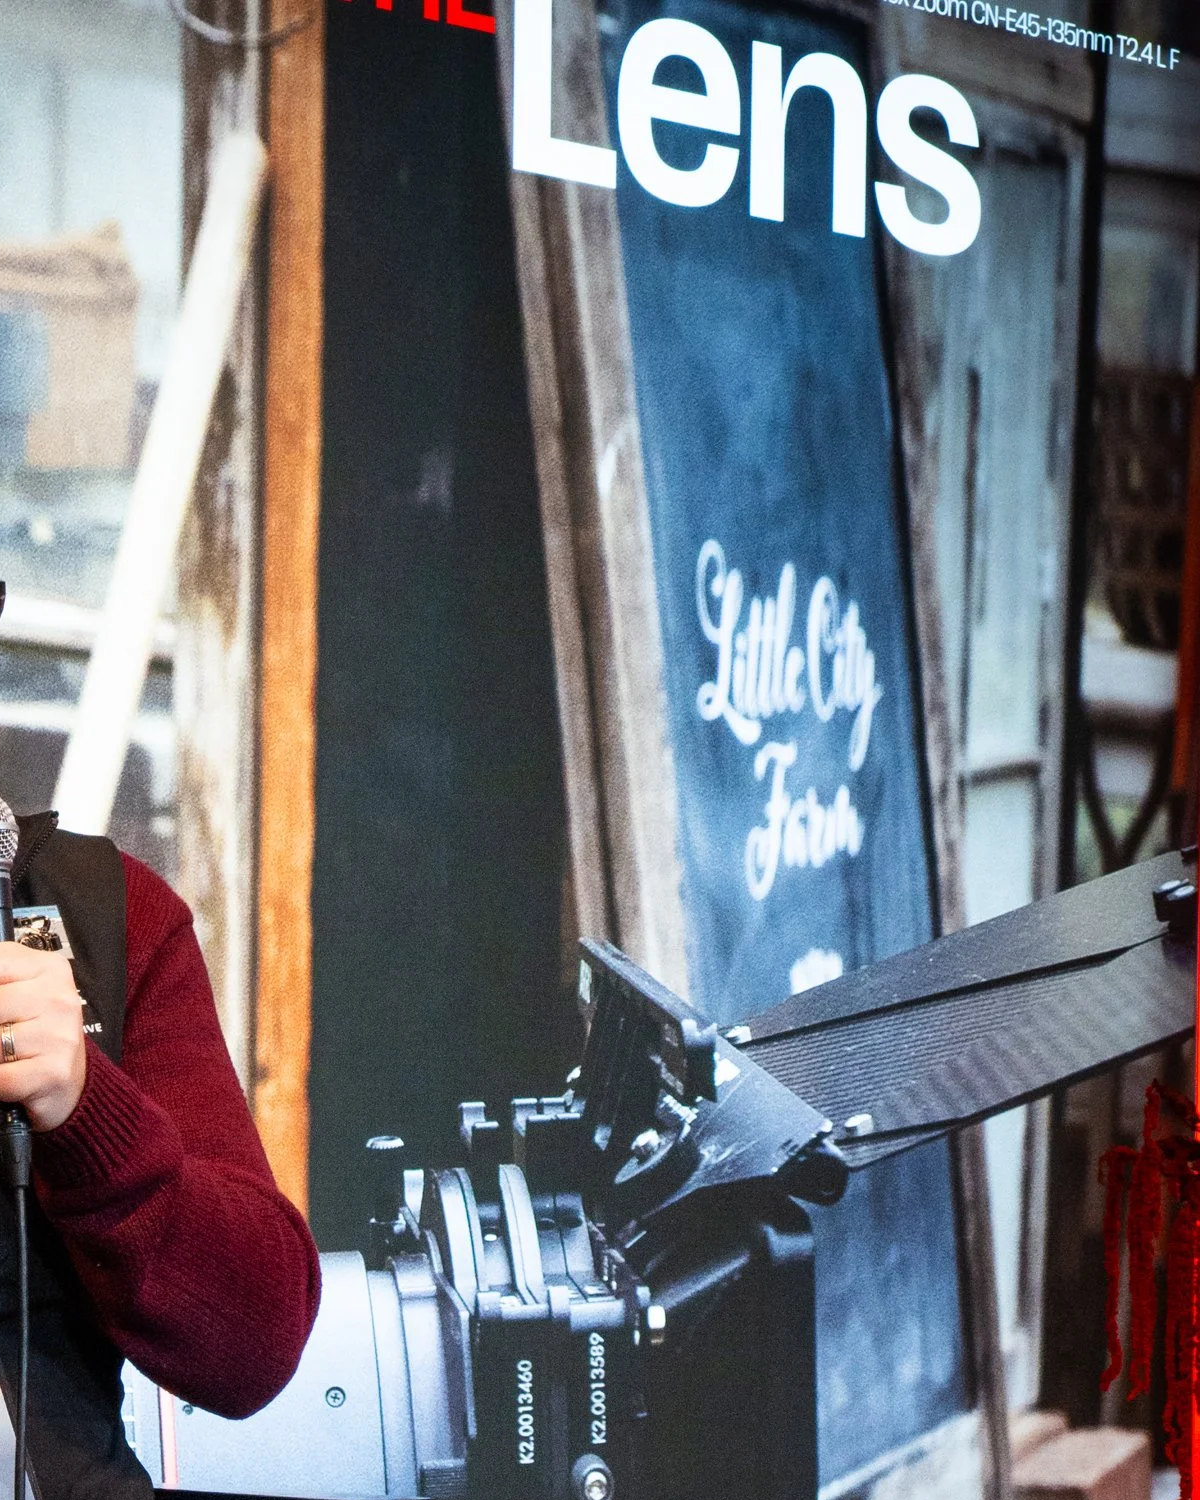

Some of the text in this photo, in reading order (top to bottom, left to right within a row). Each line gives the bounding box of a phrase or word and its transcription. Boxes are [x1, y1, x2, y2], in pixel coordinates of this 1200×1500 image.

[971, 1, 1113, 55] CN-E45-135mm
[1116, 34, 1153, 65] T2.4
[511, 0, 982, 256] Lens
[697, 538, 884, 772] Little City
[744, 742, 865, 902] Farm
[83, 1023, 103, 1033] IVE
[516, 1359, 535, 1465] K2.0013460
[588, 1332, 607, 1445] K2.0013589
